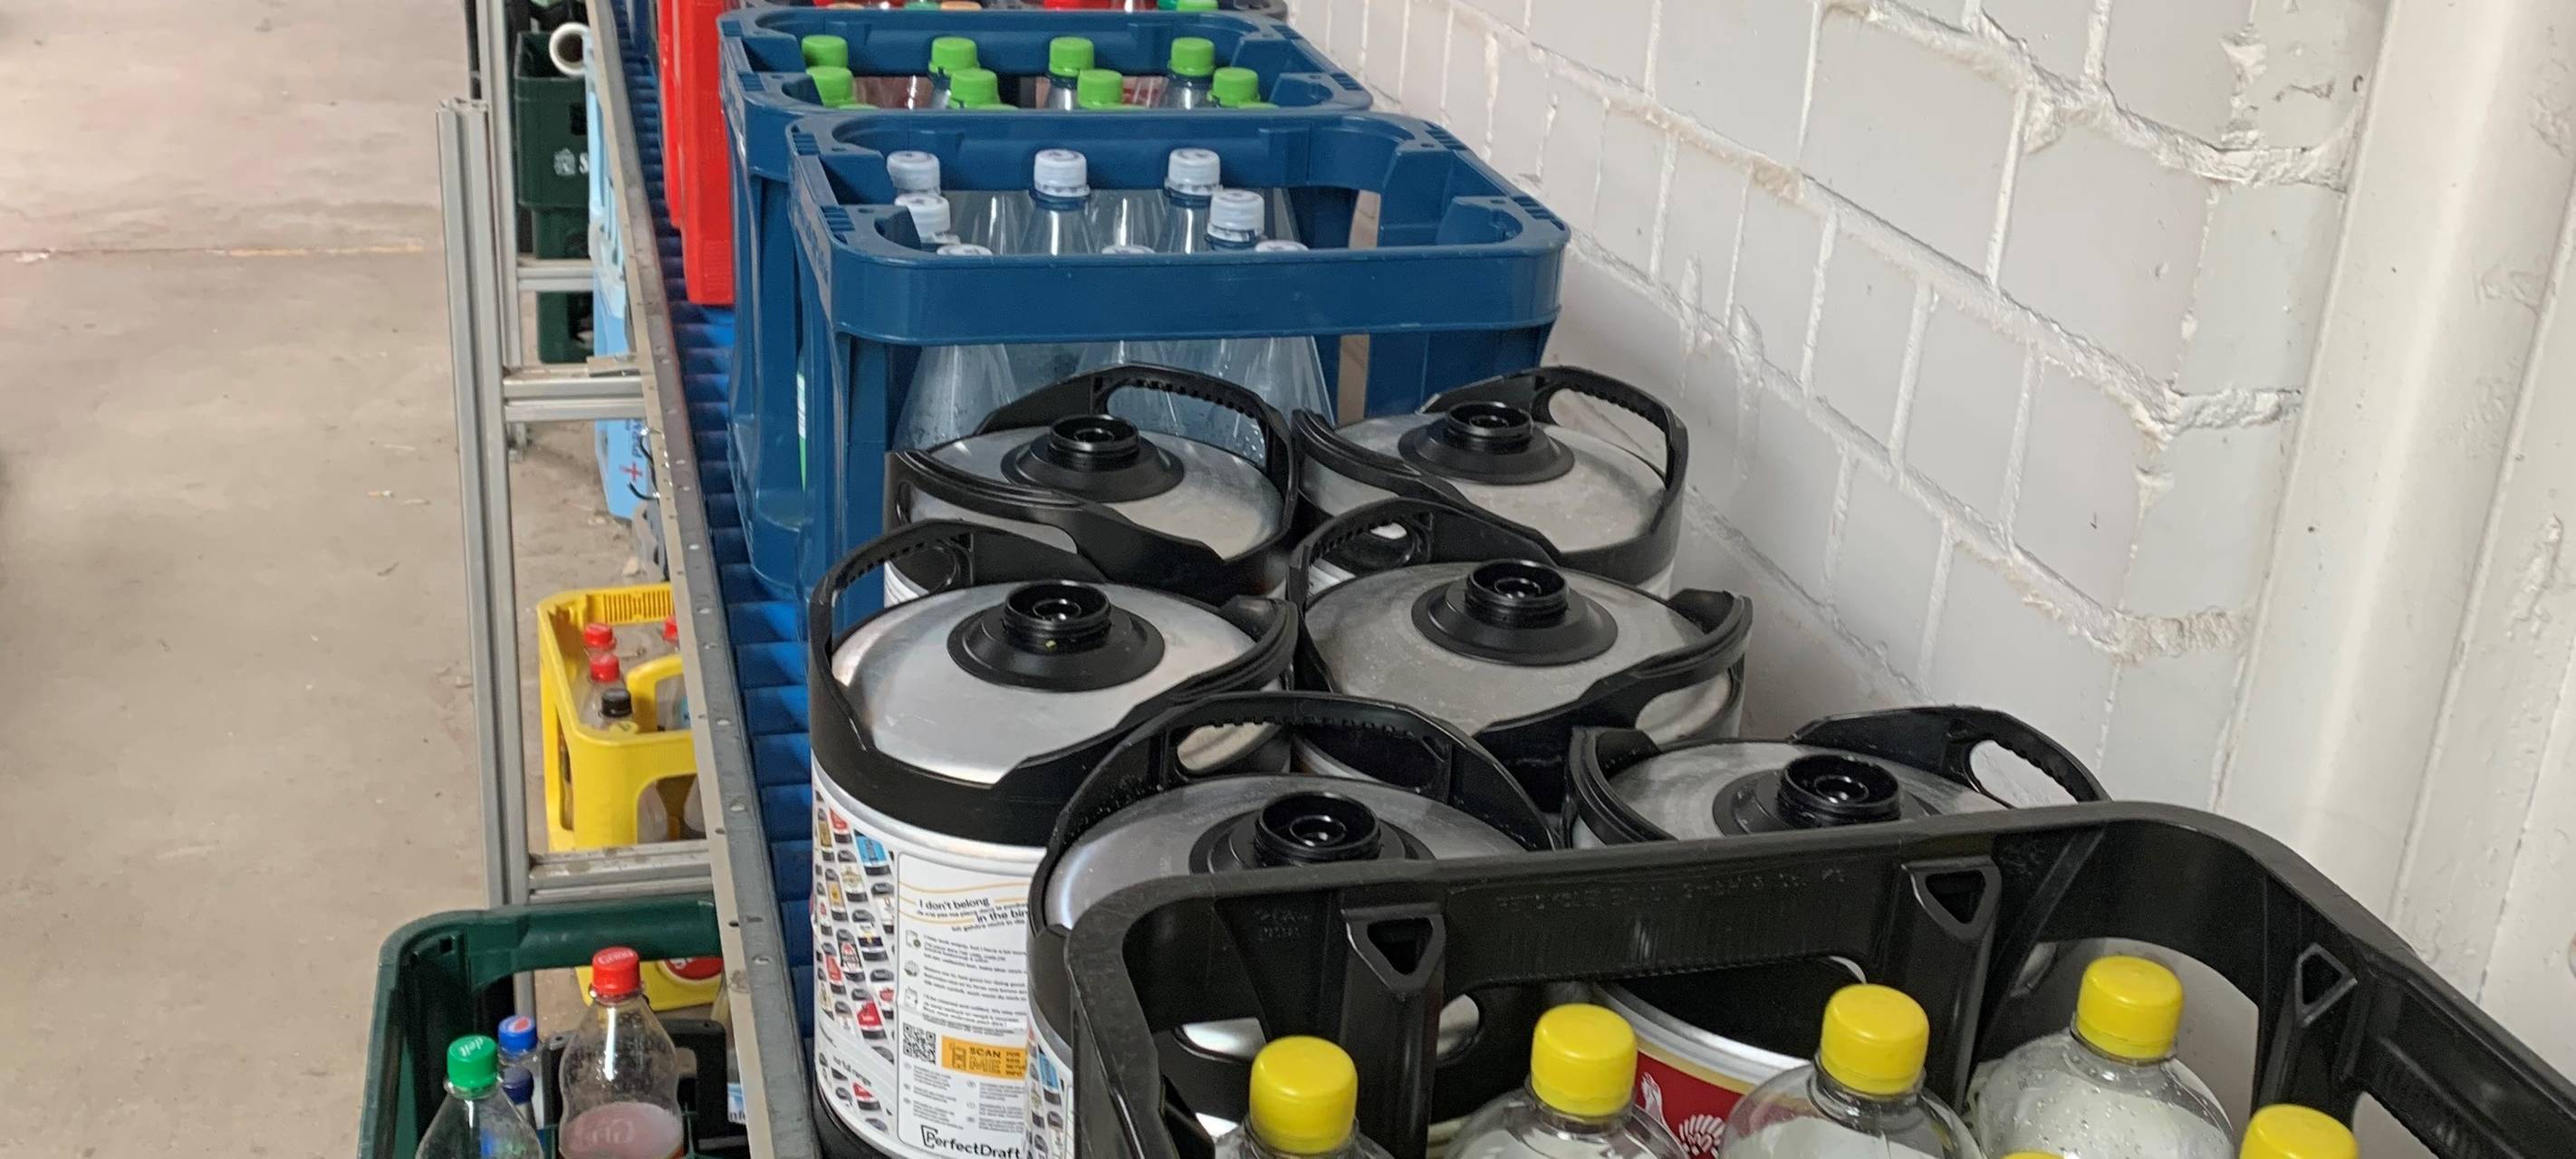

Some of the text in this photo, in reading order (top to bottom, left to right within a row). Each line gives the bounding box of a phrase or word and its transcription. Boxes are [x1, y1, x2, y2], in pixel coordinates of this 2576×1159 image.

[925, 899, 952, 911] don't
[953, 898, 991, 909] belong
[989, 911, 1008, 921] the
[969, 1046, 1001, 1058] SCAN
[969, 1056, 1002, 1075] ME
[923, 1128, 1020, 1159] PerfectDraft
